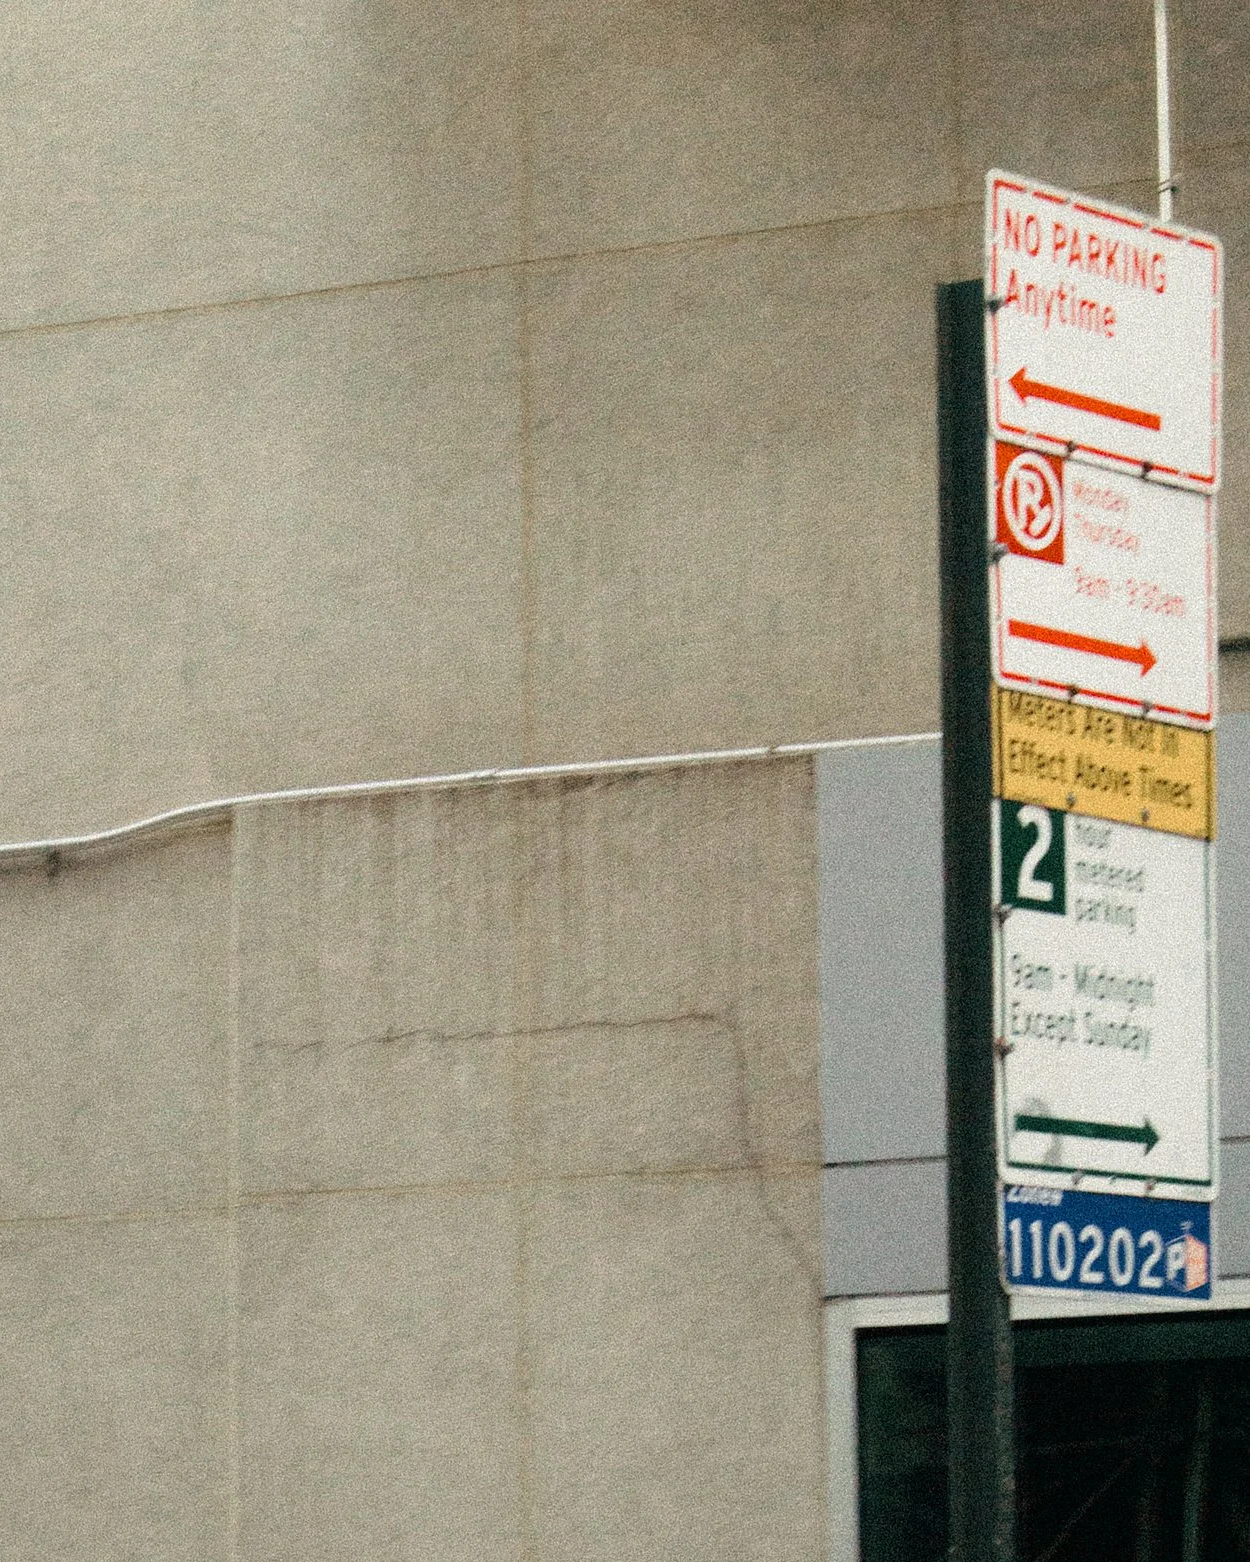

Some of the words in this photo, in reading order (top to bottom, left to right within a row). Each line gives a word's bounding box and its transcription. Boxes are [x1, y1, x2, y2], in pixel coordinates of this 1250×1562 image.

[1004, 208, 1040, 257] NO
[1053, 222, 1166, 293] PARKING
[1005, 268, 1116, 338] Anytime
[1008, 691, 1075, 735] Meters
[1081, 706, 1116, 744] Are
[1122, 716, 1155, 753] Not
[1008, 737, 1067, 784] Effect
[1075, 753, 1131, 797] Above
[1139, 764, 1193, 809] Times
[1016, 804, 1054, 902] 2
[1074, 963, 1155, 1011] Midnight
[1010, 999, 1076, 1047] Except
[1084, 1011, 1153, 1061] Sunday
[1008, 1217, 1165, 1289] 110202
